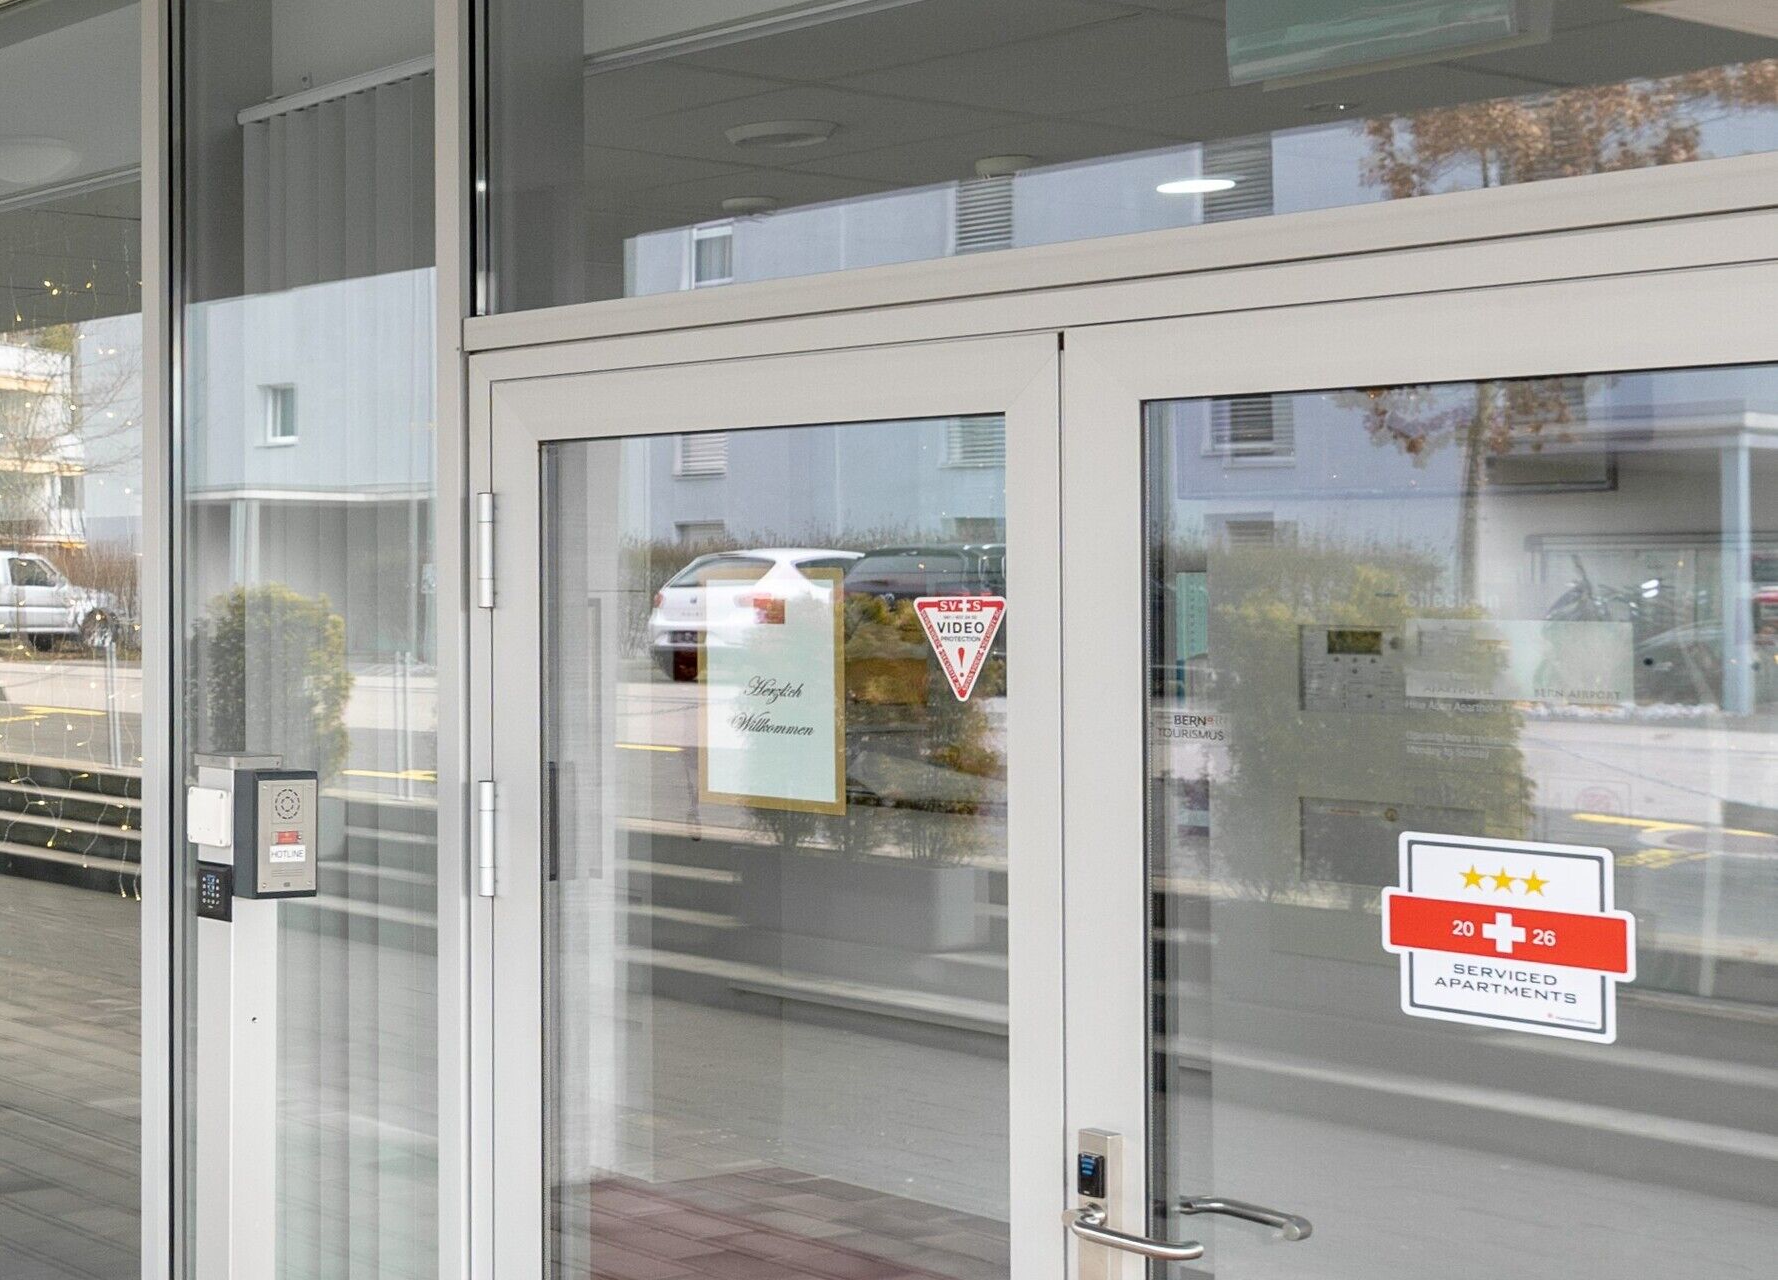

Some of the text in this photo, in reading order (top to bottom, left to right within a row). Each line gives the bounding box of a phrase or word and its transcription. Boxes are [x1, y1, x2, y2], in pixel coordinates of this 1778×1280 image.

[937, 621, 985, 634] VIDEO
[743, 675, 804, 705] Herzlich
[730, 711, 814, 736] Willkommen
[1157, 727, 1225, 741] TOURISMUS
[271, 849, 304, 859] HOTLINE
[1452, 920, 1557, 947] 20 26
[1453, 963, 1558, 986] SERVICED
[1434, 976, 1578, 1005] APARTMENTS
